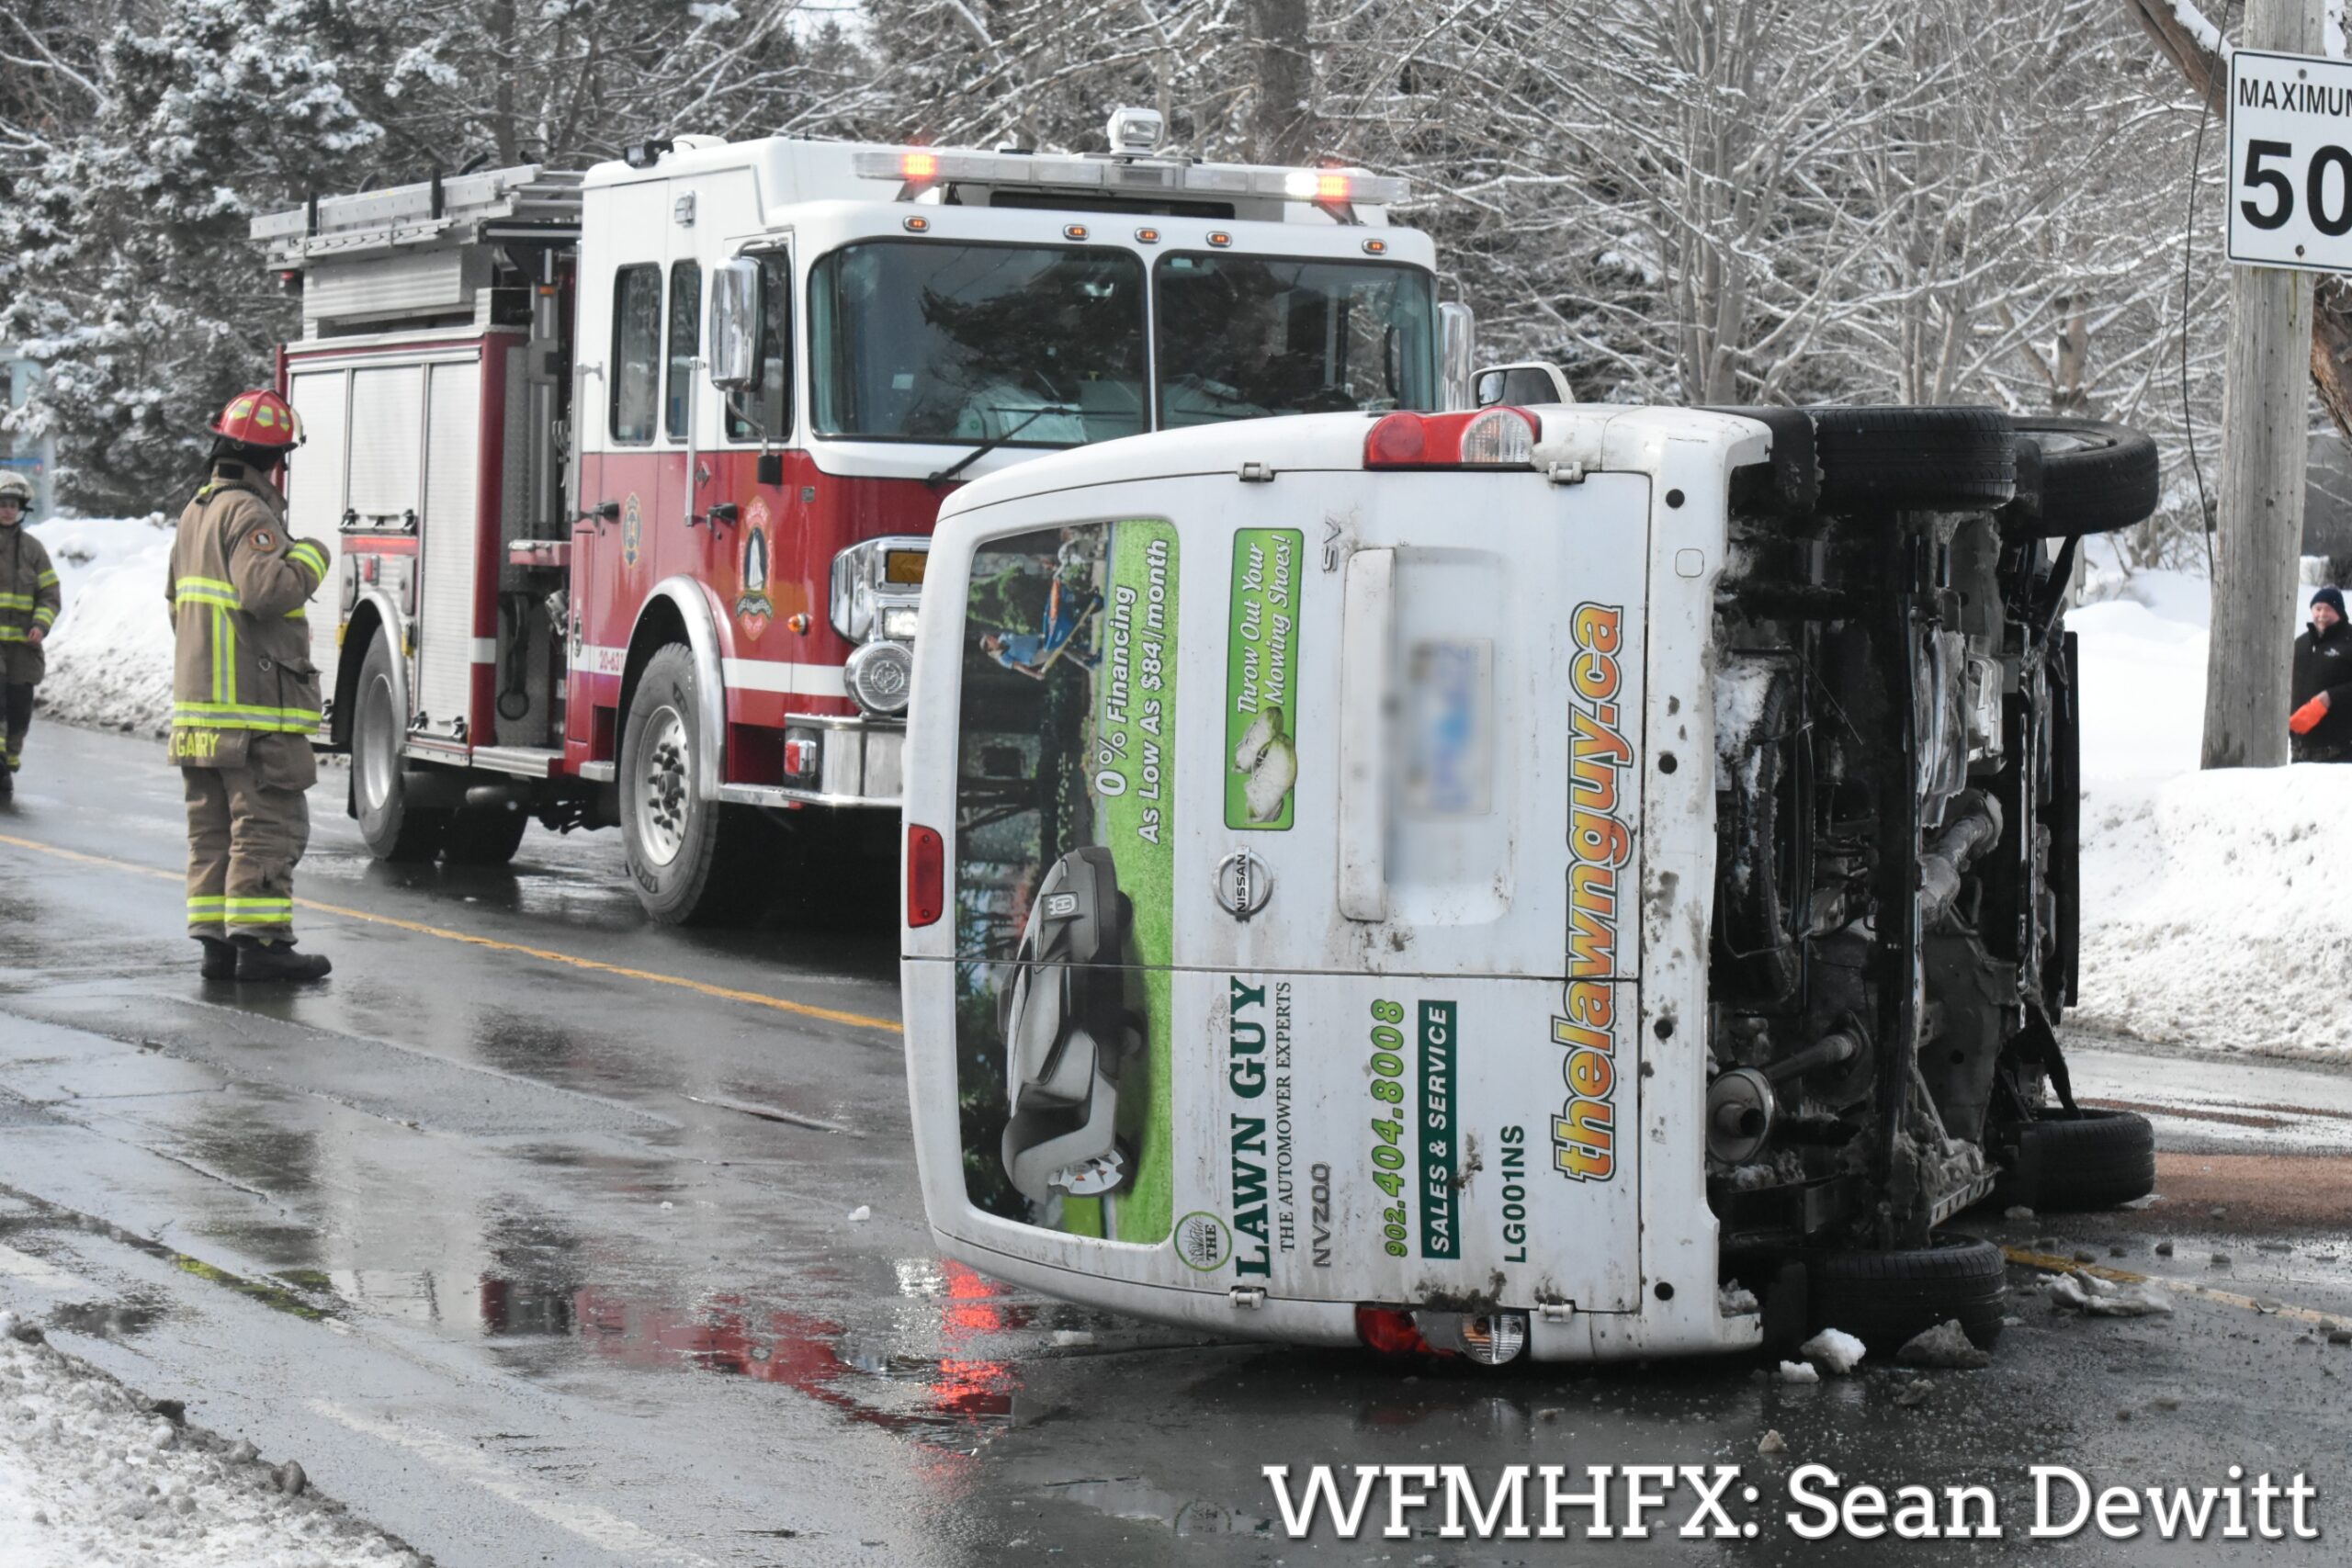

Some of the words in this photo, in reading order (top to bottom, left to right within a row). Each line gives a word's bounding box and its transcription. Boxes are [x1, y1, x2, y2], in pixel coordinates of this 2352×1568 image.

[2241, 139, 2352, 236] 50
[1242, 542, 1265, 592] Your
[1269, 535, 1293, 608] Shoes!
[1323, 516, 1341, 574] SV
[1107, 584, 1137, 724] Financing
[1141, 538, 1169, 692] $84/month
[1239, 596, 1262, 640] Out
[1238, 645, 1259, 713] Throw
[1264, 615, 1291, 705] Mowing
[1139, 701, 1161, 738] As
[1139, 740, 1160, 800] Low
[1138, 806, 1160, 844] As
[1237, 854, 1247, 913] NISSAN
[1551, 601, 1634, 1183] thelawnguy.ca
[1229, 976, 1266, 1099] GUY
[1276, 981, 1292, 1073] EXPERTS
[1428, 1008, 1447, 1130] SERVICE
[1277, 1076, 1295, 1207] AUTOMOWER
[1371, 998, 1408, 1258] 902.404.8008
[1429, 1138, 1448, 1159] &
[1230, 1112, 1271, 1279] LAWN
[1280, 1213, 1295, 1253] THE
[1430, 1164, 1450, 1252] SALES
[1500, 1123, 1526, 1263] LG001NS
[1206, 1224, 1217, 1260] THE
